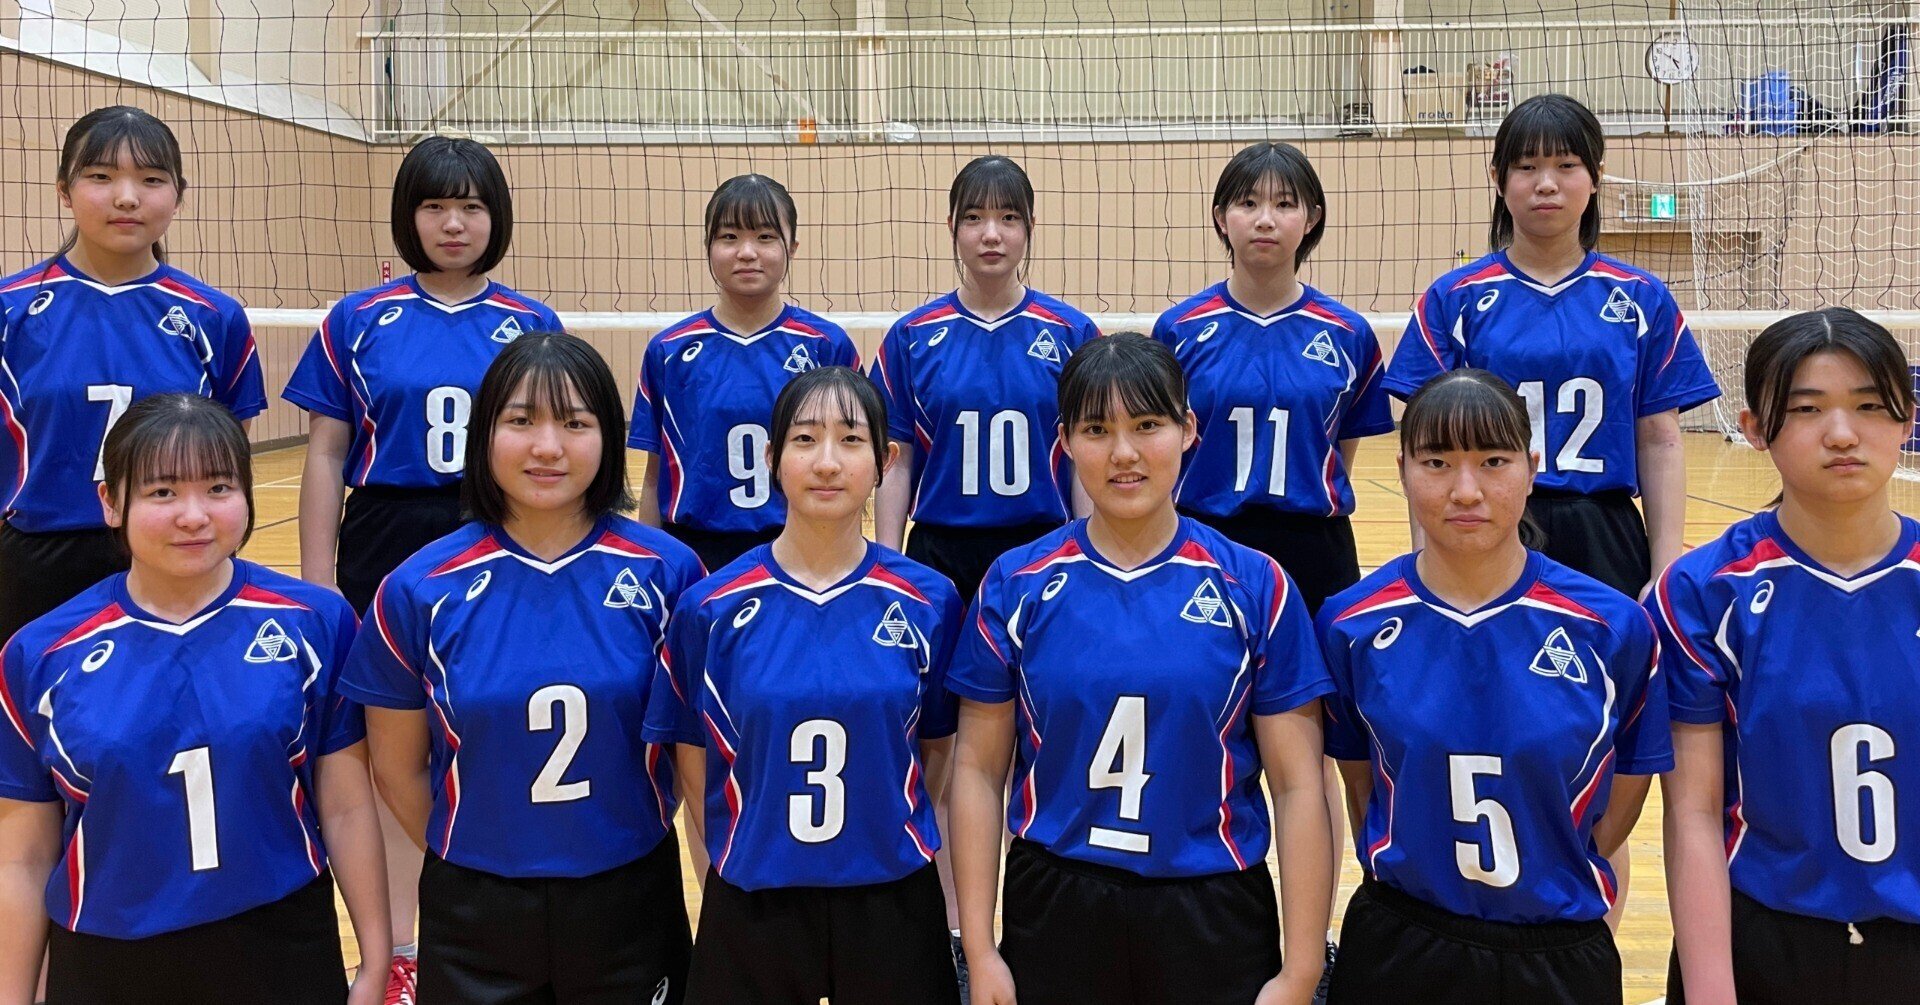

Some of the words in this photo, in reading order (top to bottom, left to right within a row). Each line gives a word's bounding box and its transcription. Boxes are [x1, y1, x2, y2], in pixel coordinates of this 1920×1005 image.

[87, 384, 133, 481] 7
[426, 386, 472, 474] 8
[727, 423, 771, 509] 9
[955, 409, 1031, 496] 10
[1227, 406, 1290, 497] 11
[1516, 377, 1604, 473] 12
[528, 684, 591, 803] 2
[788, 719, 848, 843] 3
[1089, 696, 1151, 820] 4
[1830, 723, 1896, 863] 6
[167, 746, 219, 872] 1
[1449, 754, 1520, 888] 5
